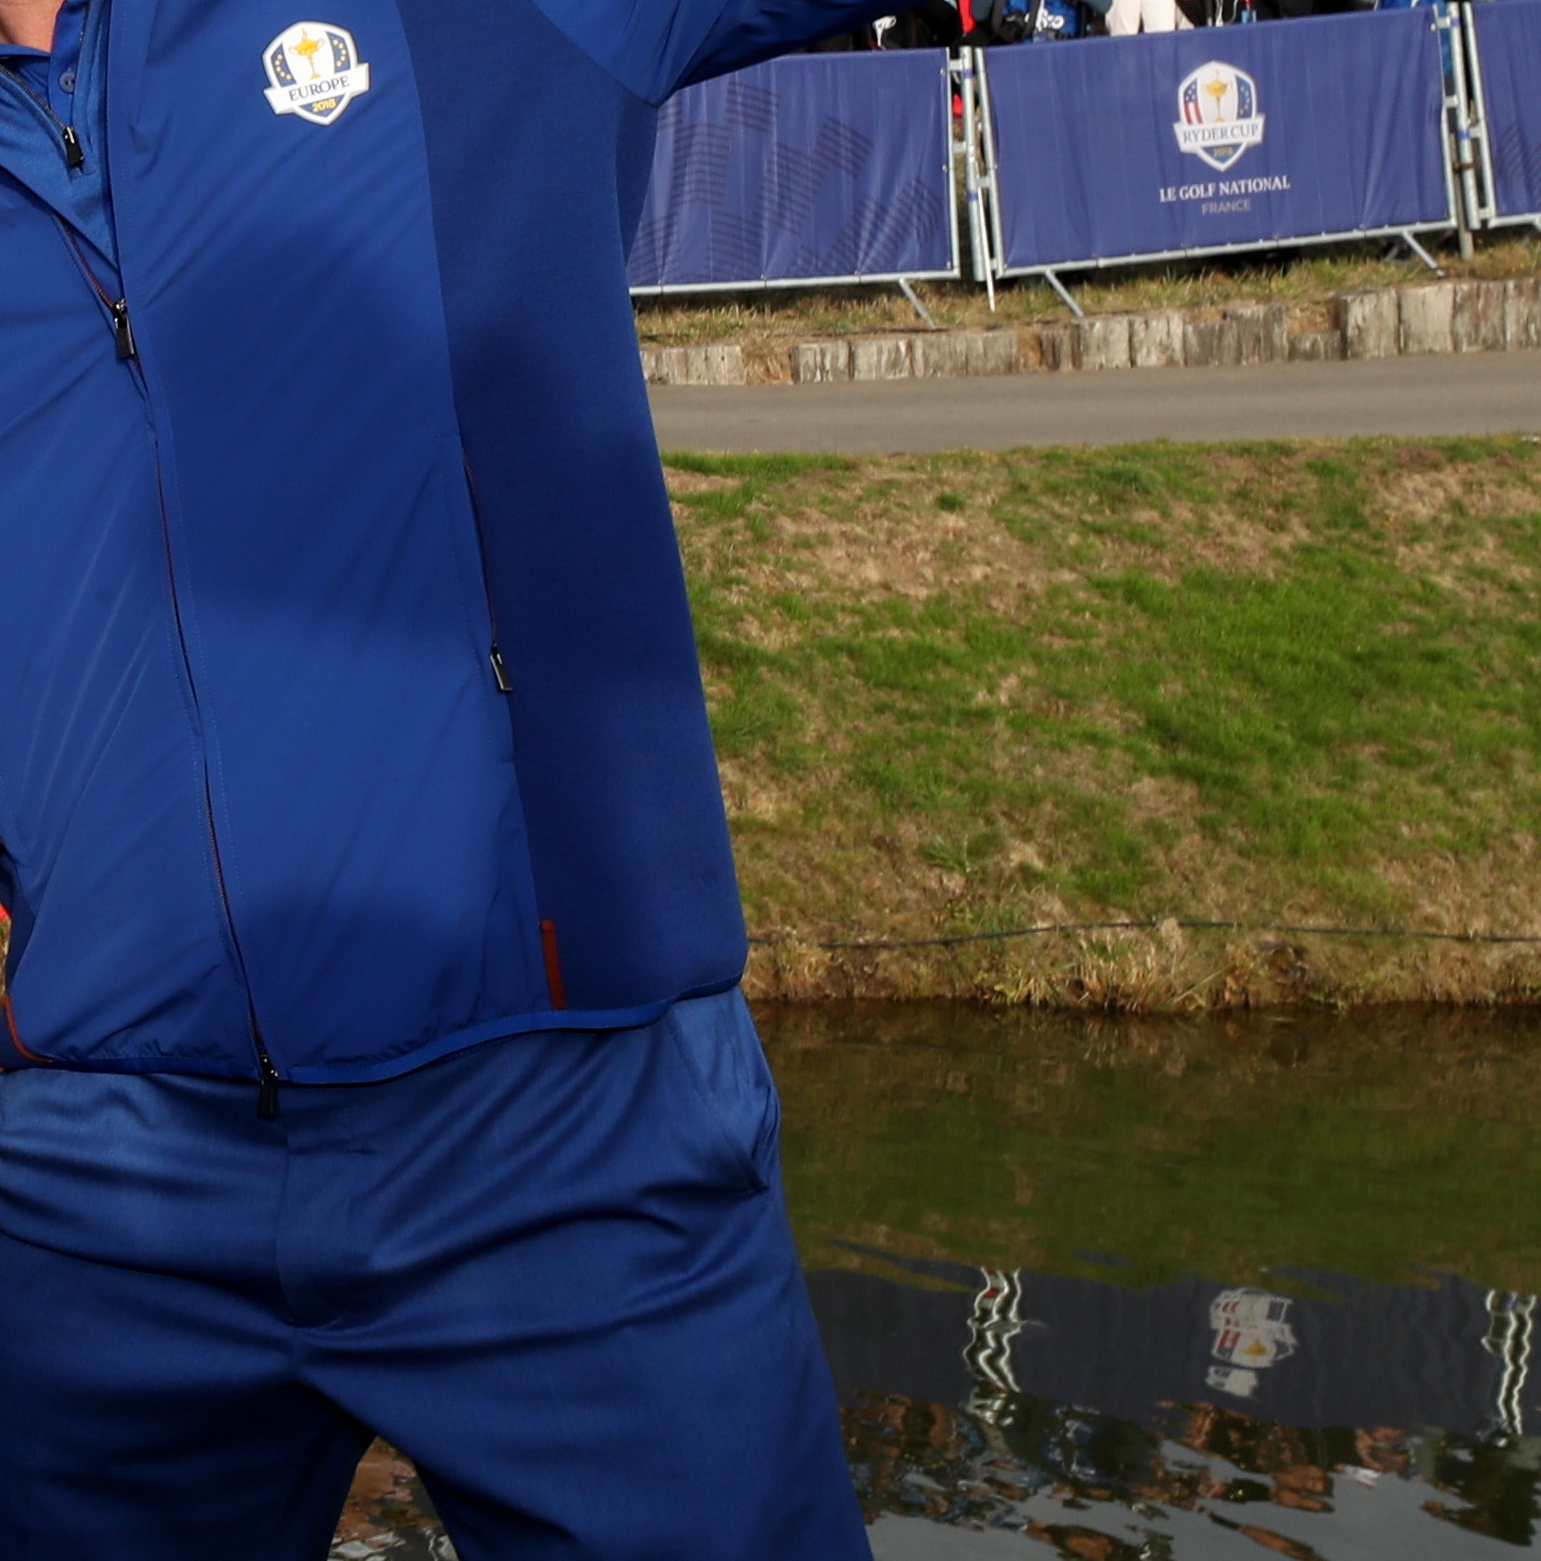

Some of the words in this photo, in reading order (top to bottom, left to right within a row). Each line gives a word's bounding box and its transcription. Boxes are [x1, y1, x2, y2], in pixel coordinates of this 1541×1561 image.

[288, 75, 350, 101] EUROPE
[311, 98, 336, 112] 2018
[1182, 127, 1229, 144] RYDER
[1230, 123, 1259, 138] CUP
[1159, 187, 1177, 202] LE
[1179, 182, 1216, 200] GOLF
[1219, 175, 1291, 196] NATIONAL
[1201, 199, 1251, 215] FRANCE
